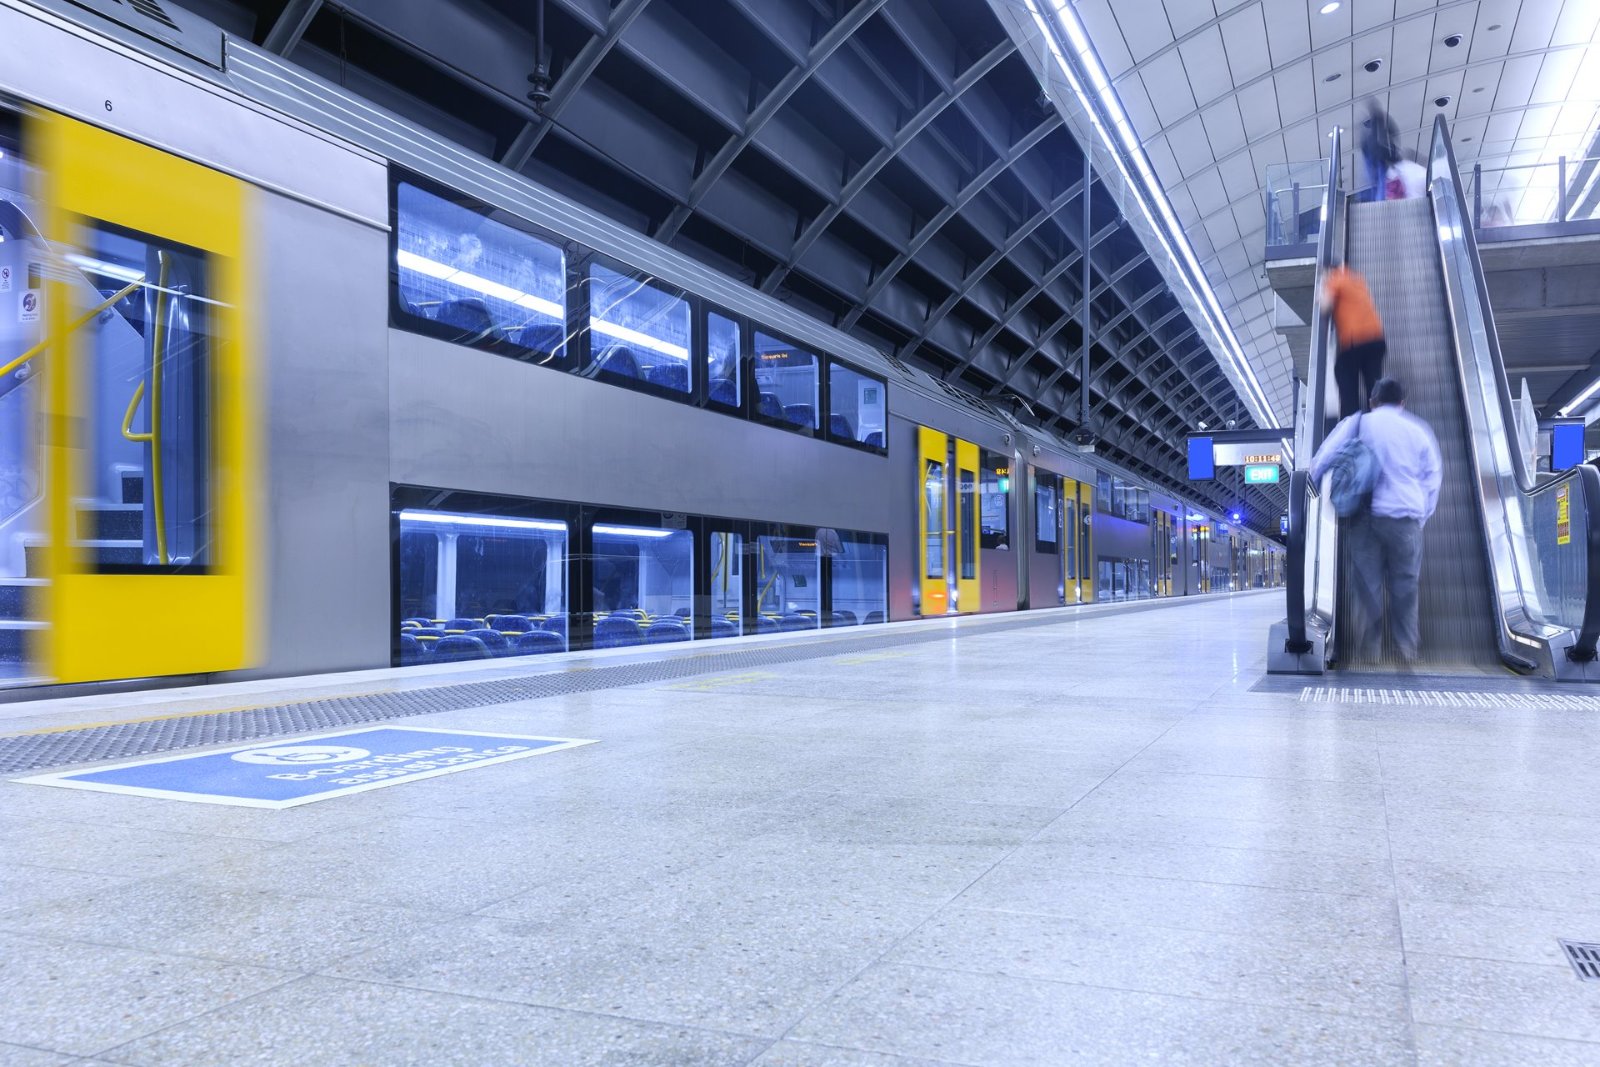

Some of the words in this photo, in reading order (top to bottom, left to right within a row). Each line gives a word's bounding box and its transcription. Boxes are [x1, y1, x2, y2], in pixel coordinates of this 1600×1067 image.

[104, 99, 112, 112] 6
[1251, 469, 1273, 480] EXIT
[266, 744, 474, 782] Boarding
[328, 744, 530, 784] assistance
